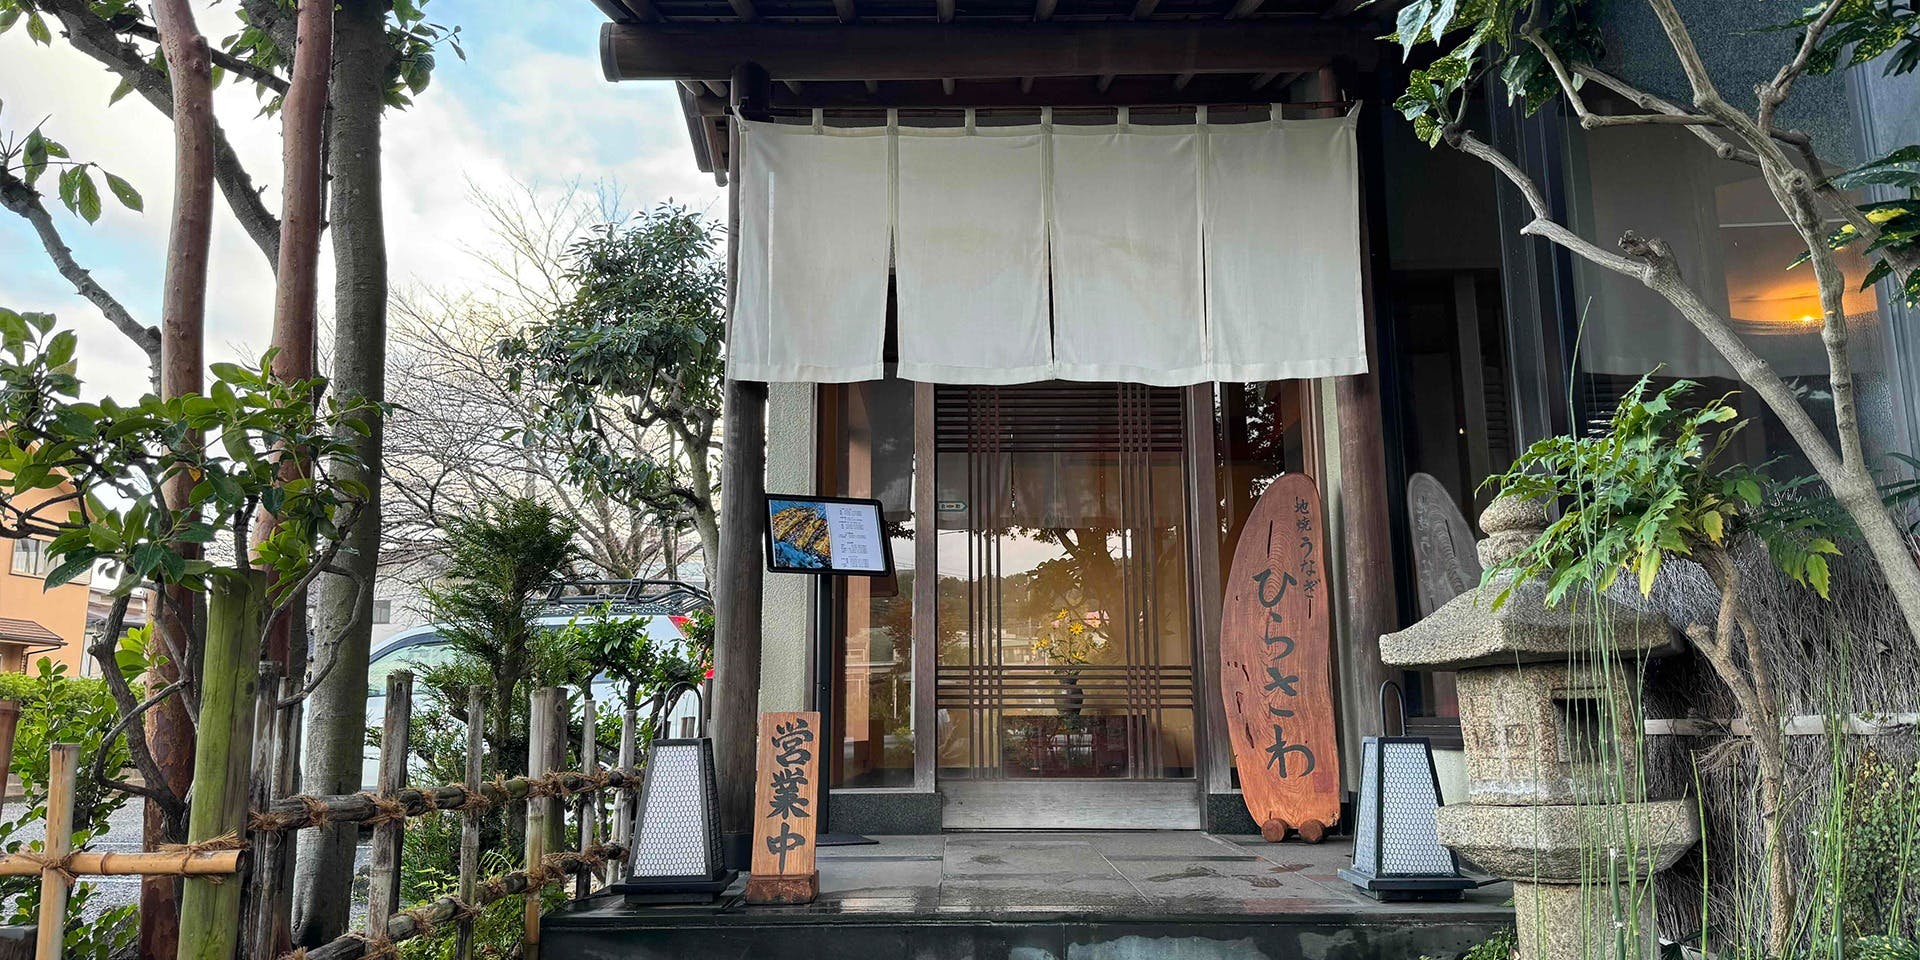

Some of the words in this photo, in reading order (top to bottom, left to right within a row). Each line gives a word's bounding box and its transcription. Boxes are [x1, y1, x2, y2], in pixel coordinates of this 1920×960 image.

[1295, 496, 1321, 599] 地焼うなぎ
[1253, 570, 1314, 778] ひらさわ
[766, 718, 814, 875] 営業中
